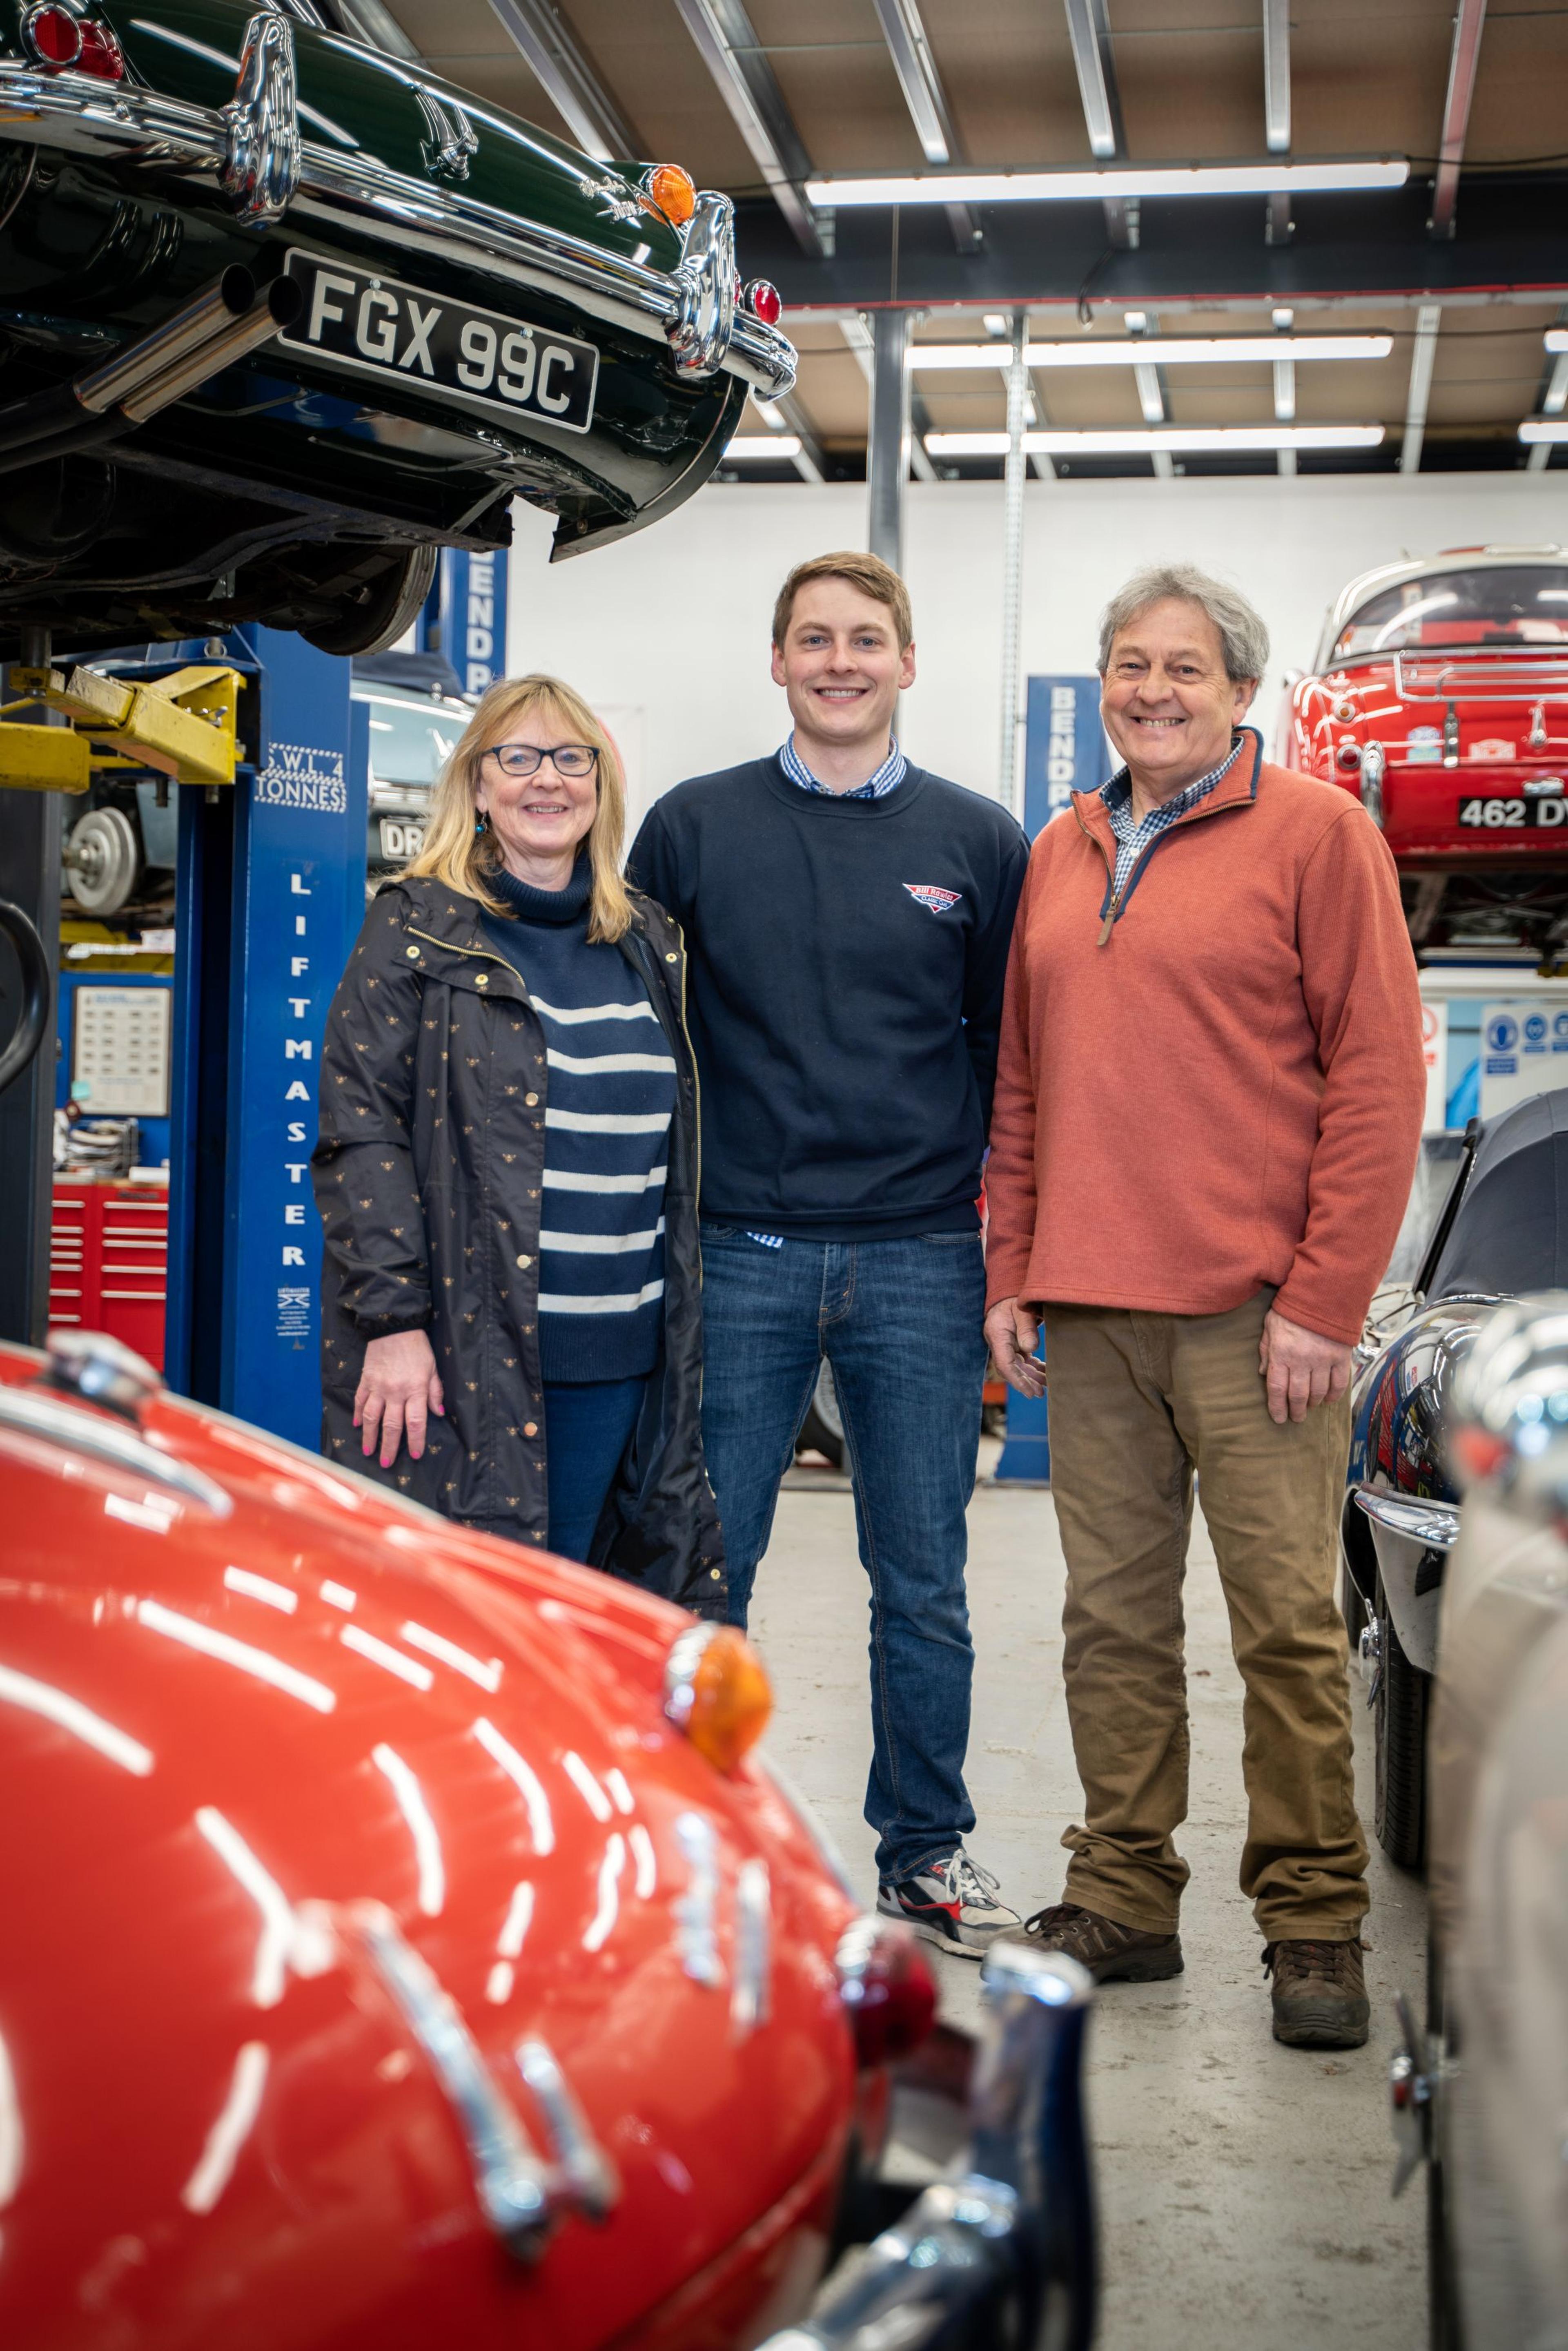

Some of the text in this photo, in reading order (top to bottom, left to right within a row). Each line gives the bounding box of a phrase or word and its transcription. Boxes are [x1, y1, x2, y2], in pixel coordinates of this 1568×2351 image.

[309, 270, 574, 413] FGX 99C
[333, 758, 343, 778] 4
[256, 776, 341, 807] TONNES
[1460, 799, 1527, 828] 462
[283, 874, 312, 1265] LIFTMASTER
